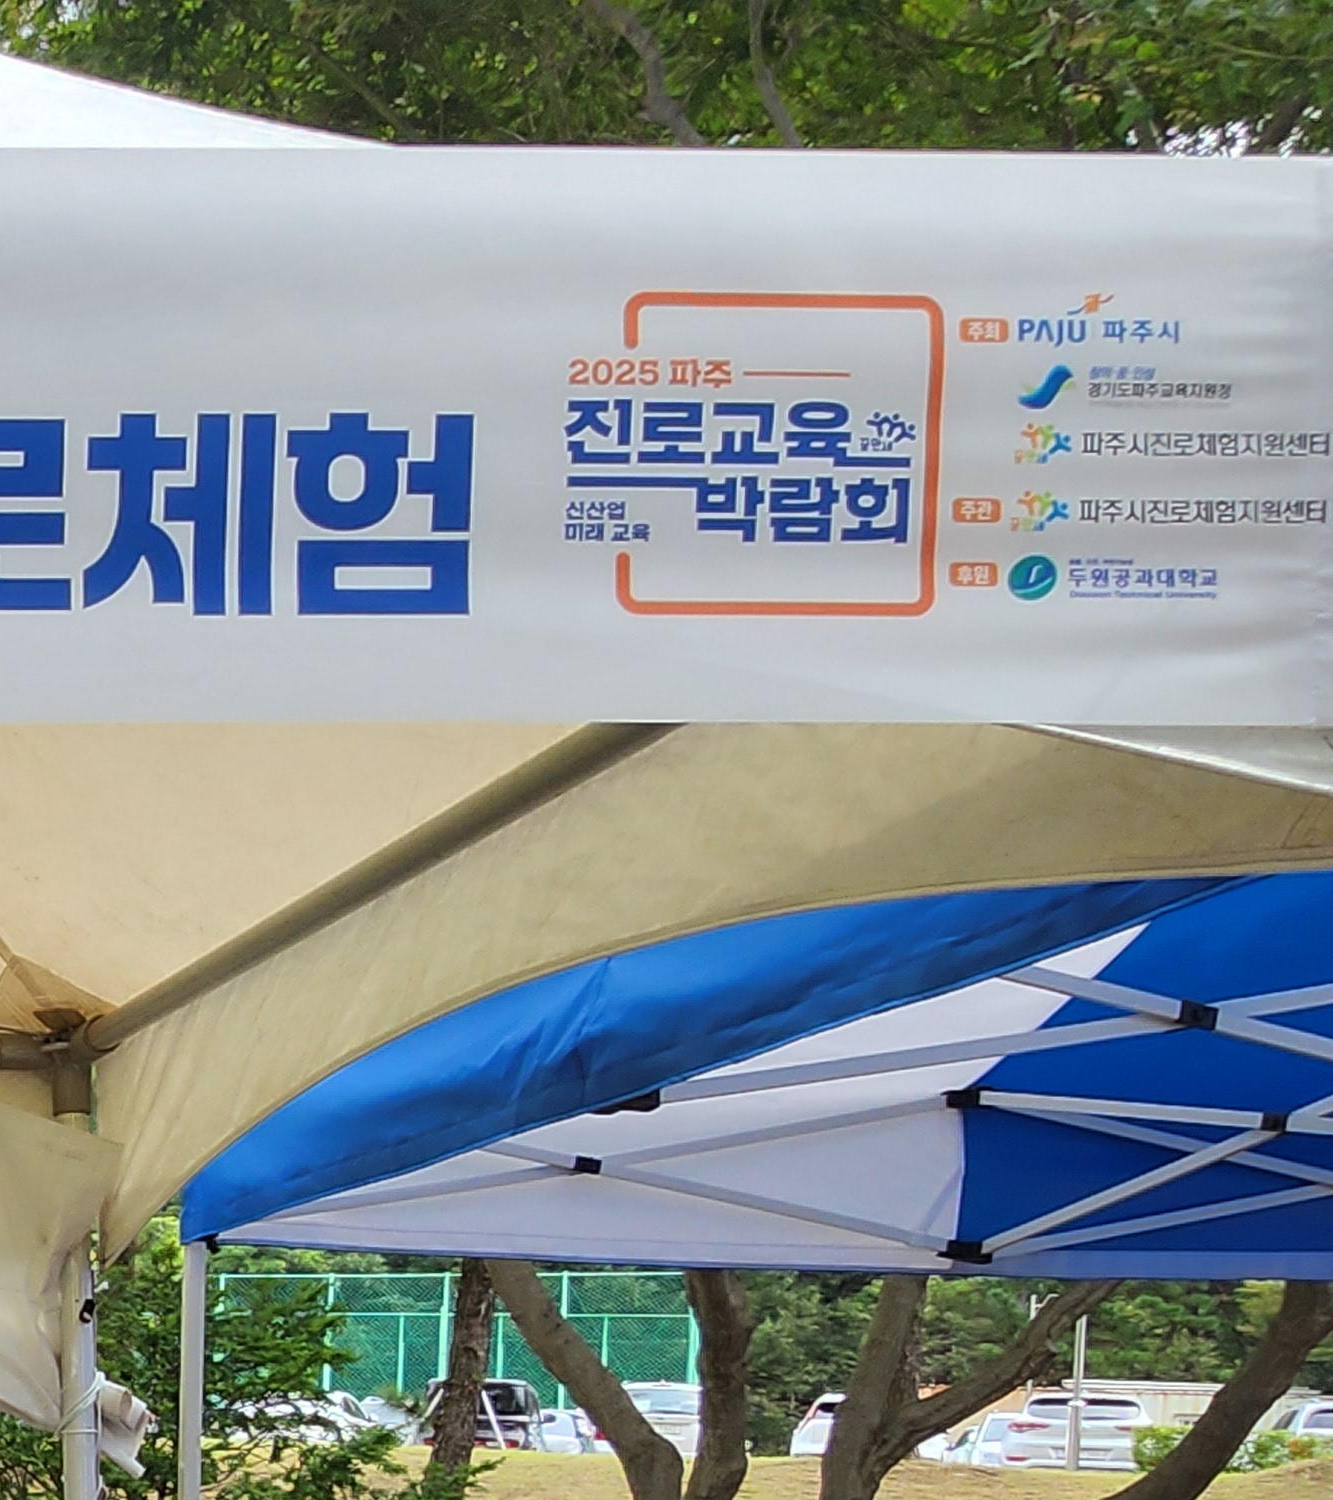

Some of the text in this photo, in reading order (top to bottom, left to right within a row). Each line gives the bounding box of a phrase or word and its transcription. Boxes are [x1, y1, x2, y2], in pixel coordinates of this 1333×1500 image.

[967, 317, 1181, 347] 주최 PAJU 파주시
[567, 358, 733, 389] 2025 파주
[563, 398, 912, 468] 진로교육
[1080, 432, 1331, 457] 파주시진로체험지원센터
[564, 500, 626, 521] 신산업
[695, 476, 912, 544] 박람회
[960, 499, 1327, 525] 주관 파주시진로체험지원센터
[563, 522, 651, 543] 미래 교육
[957, 565, 1218, 589] 후원 두원공과대학교
